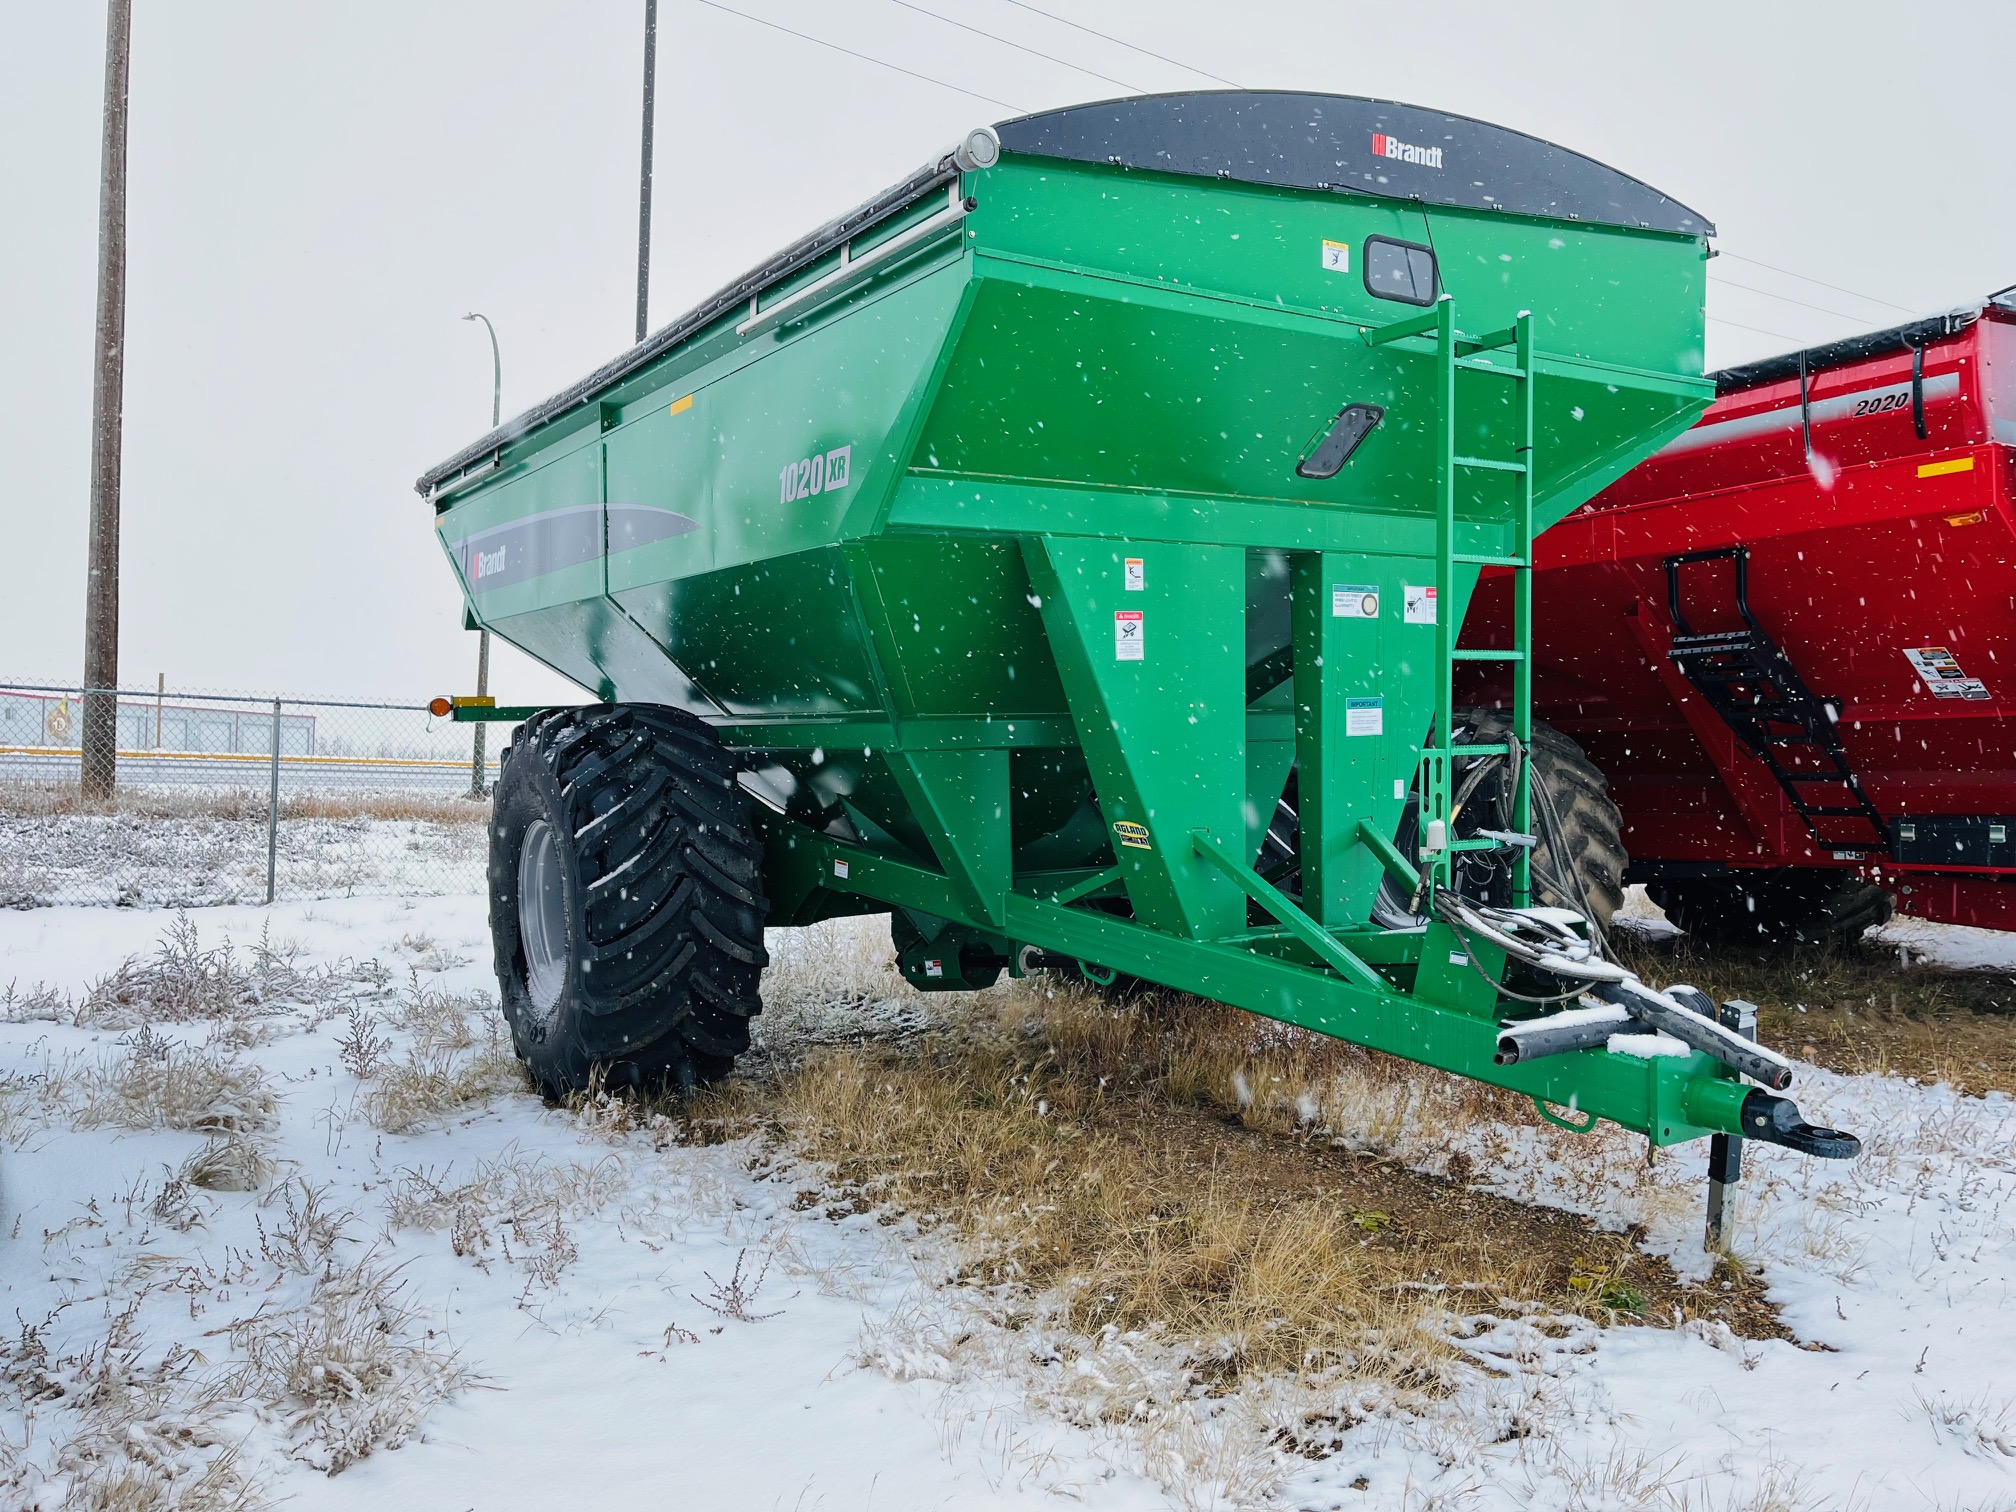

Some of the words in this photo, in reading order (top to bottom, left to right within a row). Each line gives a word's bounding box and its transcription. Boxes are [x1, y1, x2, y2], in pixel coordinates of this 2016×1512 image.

[1385, 136, 1442, 169] Brandt
[1853, 392, 1909, 417] 2020
[779, 454, 824, 505] 1020
[828, 455, 846, 483] XR
[479, 545, 506, 578] Brandt
